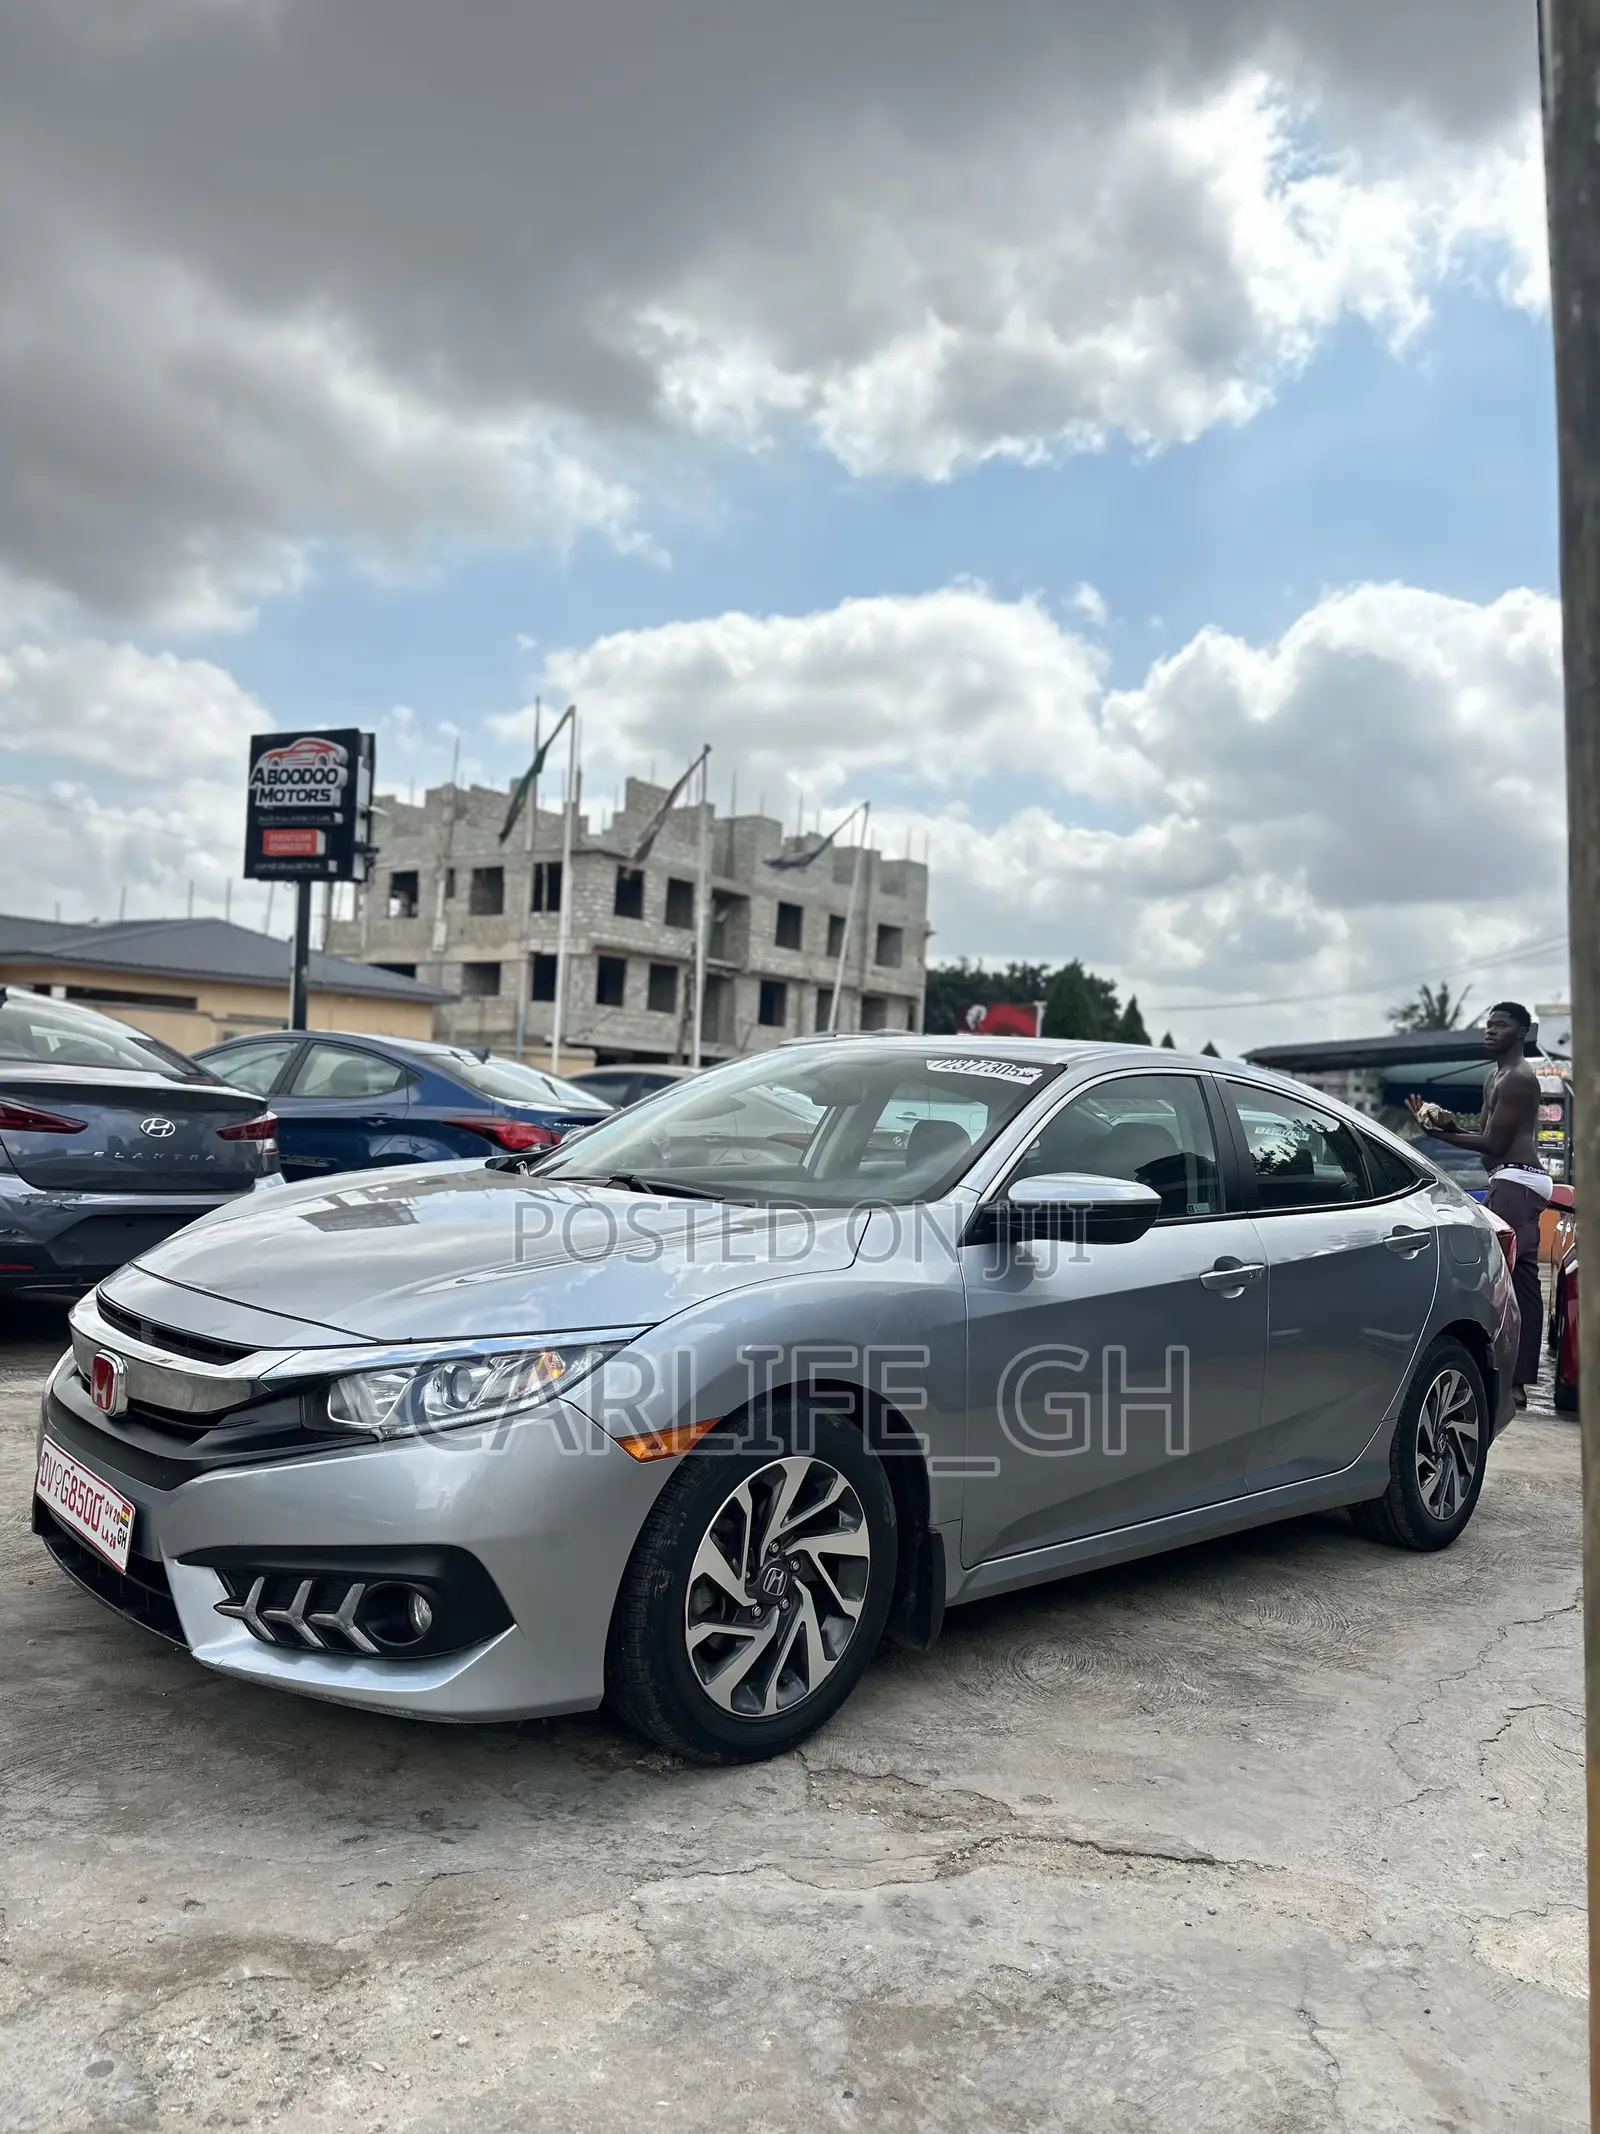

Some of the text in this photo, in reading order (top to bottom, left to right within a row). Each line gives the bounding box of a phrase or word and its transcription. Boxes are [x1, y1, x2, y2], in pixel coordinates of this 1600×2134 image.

[258, 787, 332, 803] MOTORS
[93, 1151, 216, 1161] ELANTRA
[60, 1469, 103, 1533] G8500
[117, 1527, 128, 1550] GH
